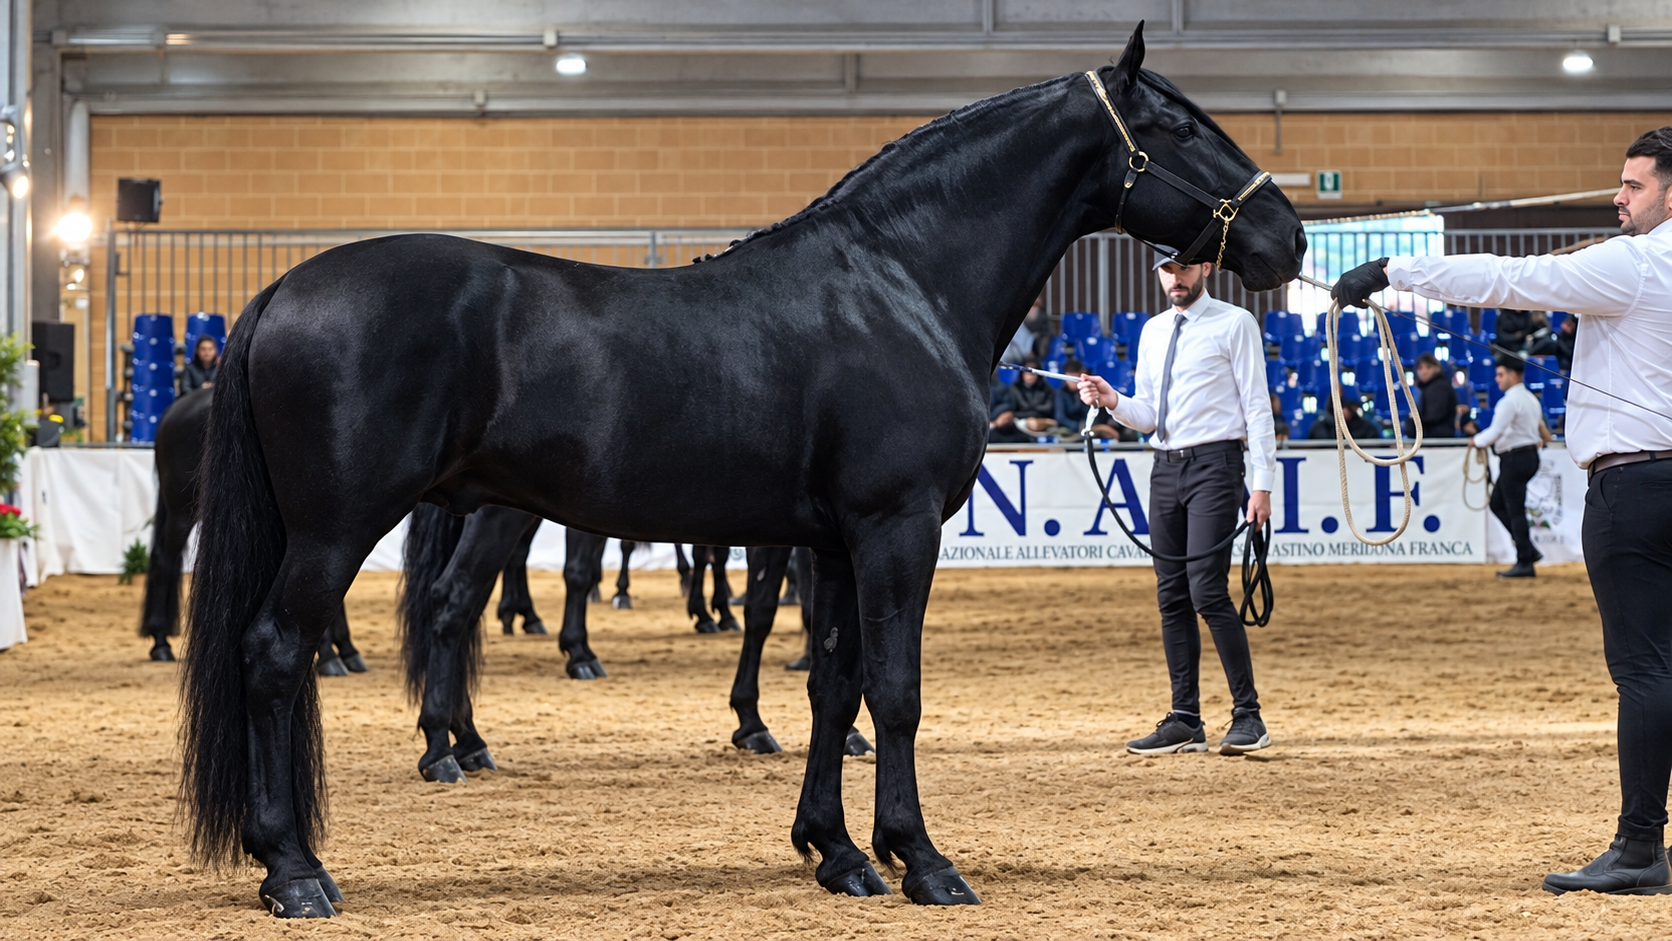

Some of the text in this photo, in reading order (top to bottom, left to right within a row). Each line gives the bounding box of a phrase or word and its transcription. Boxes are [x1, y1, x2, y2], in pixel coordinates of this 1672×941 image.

[1365, 455, 1441, 534] F.
[939, 545, 1013, 561] AZIONALE
[1016, 544, 1102, 560] ALLEVATORI
[1106, 544, 1151, 559] CAVA
[1268, 541, 1325, 557] ASTINO
[1409, 540, 1473, 556] FRANCA
